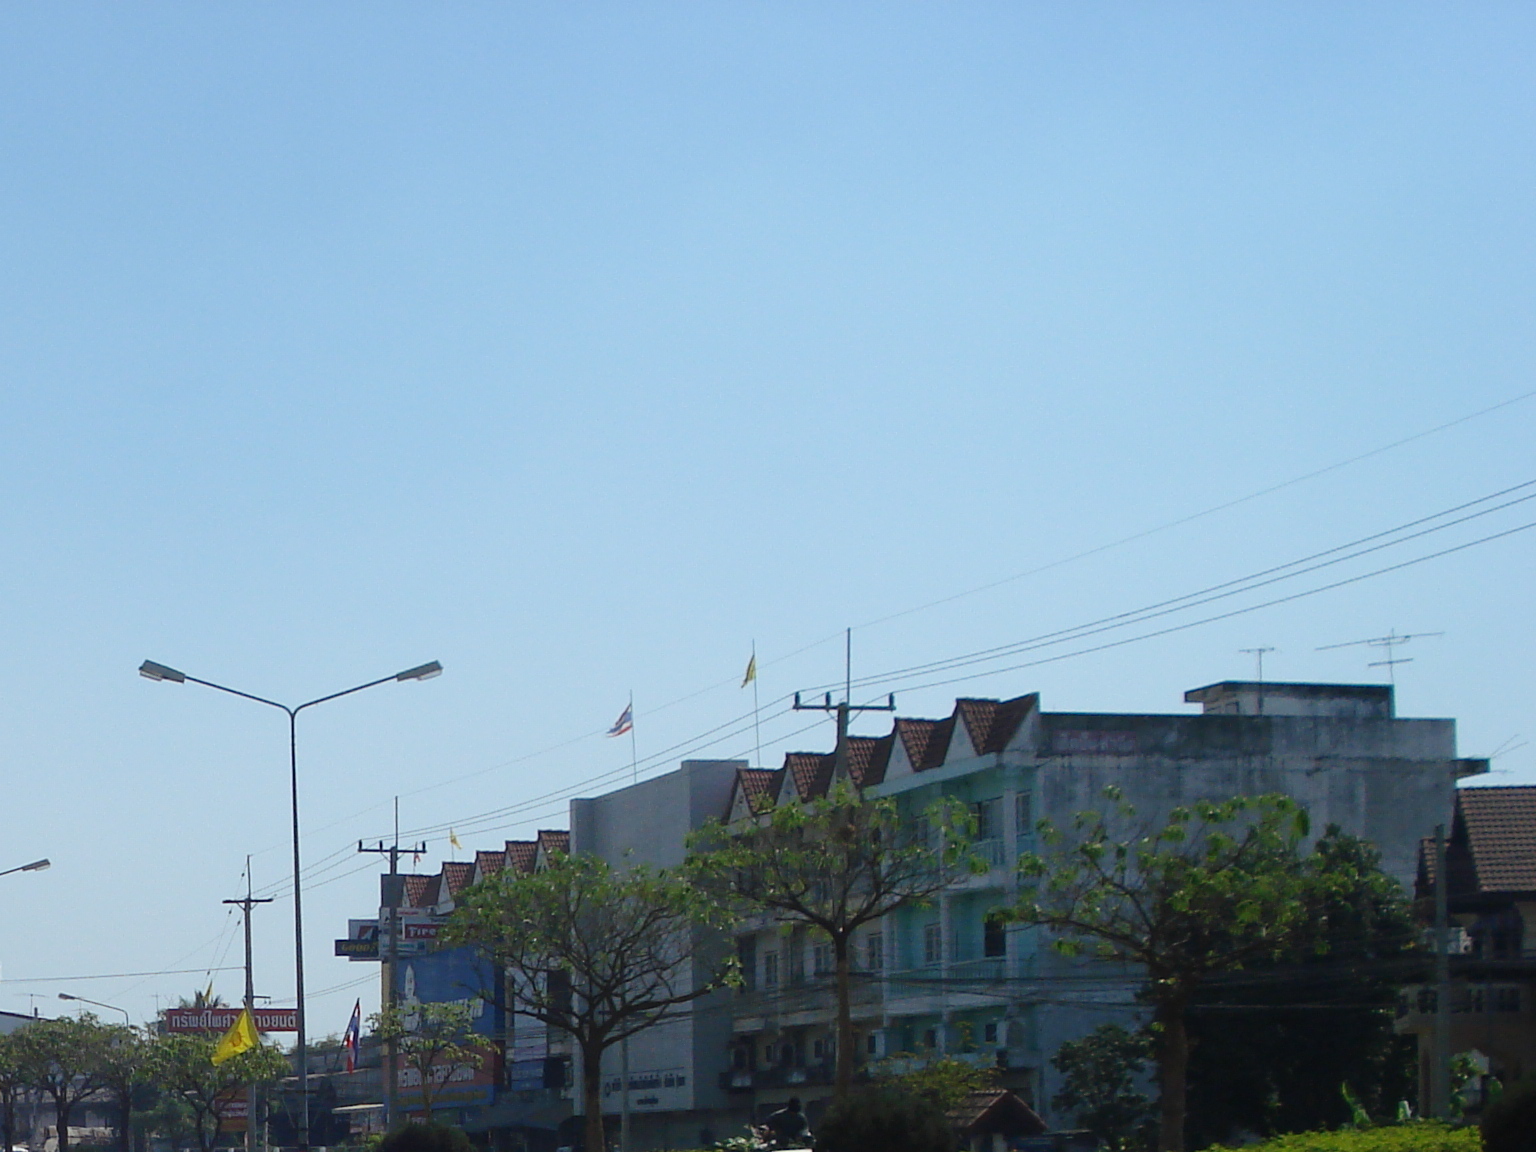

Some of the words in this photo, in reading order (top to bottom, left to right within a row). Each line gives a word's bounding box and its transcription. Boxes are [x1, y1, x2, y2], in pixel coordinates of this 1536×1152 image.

[408, 926, 437, 938] Fire
[171, 1010, 297, 1028] ทรัพย์ไพศาางยนต์
